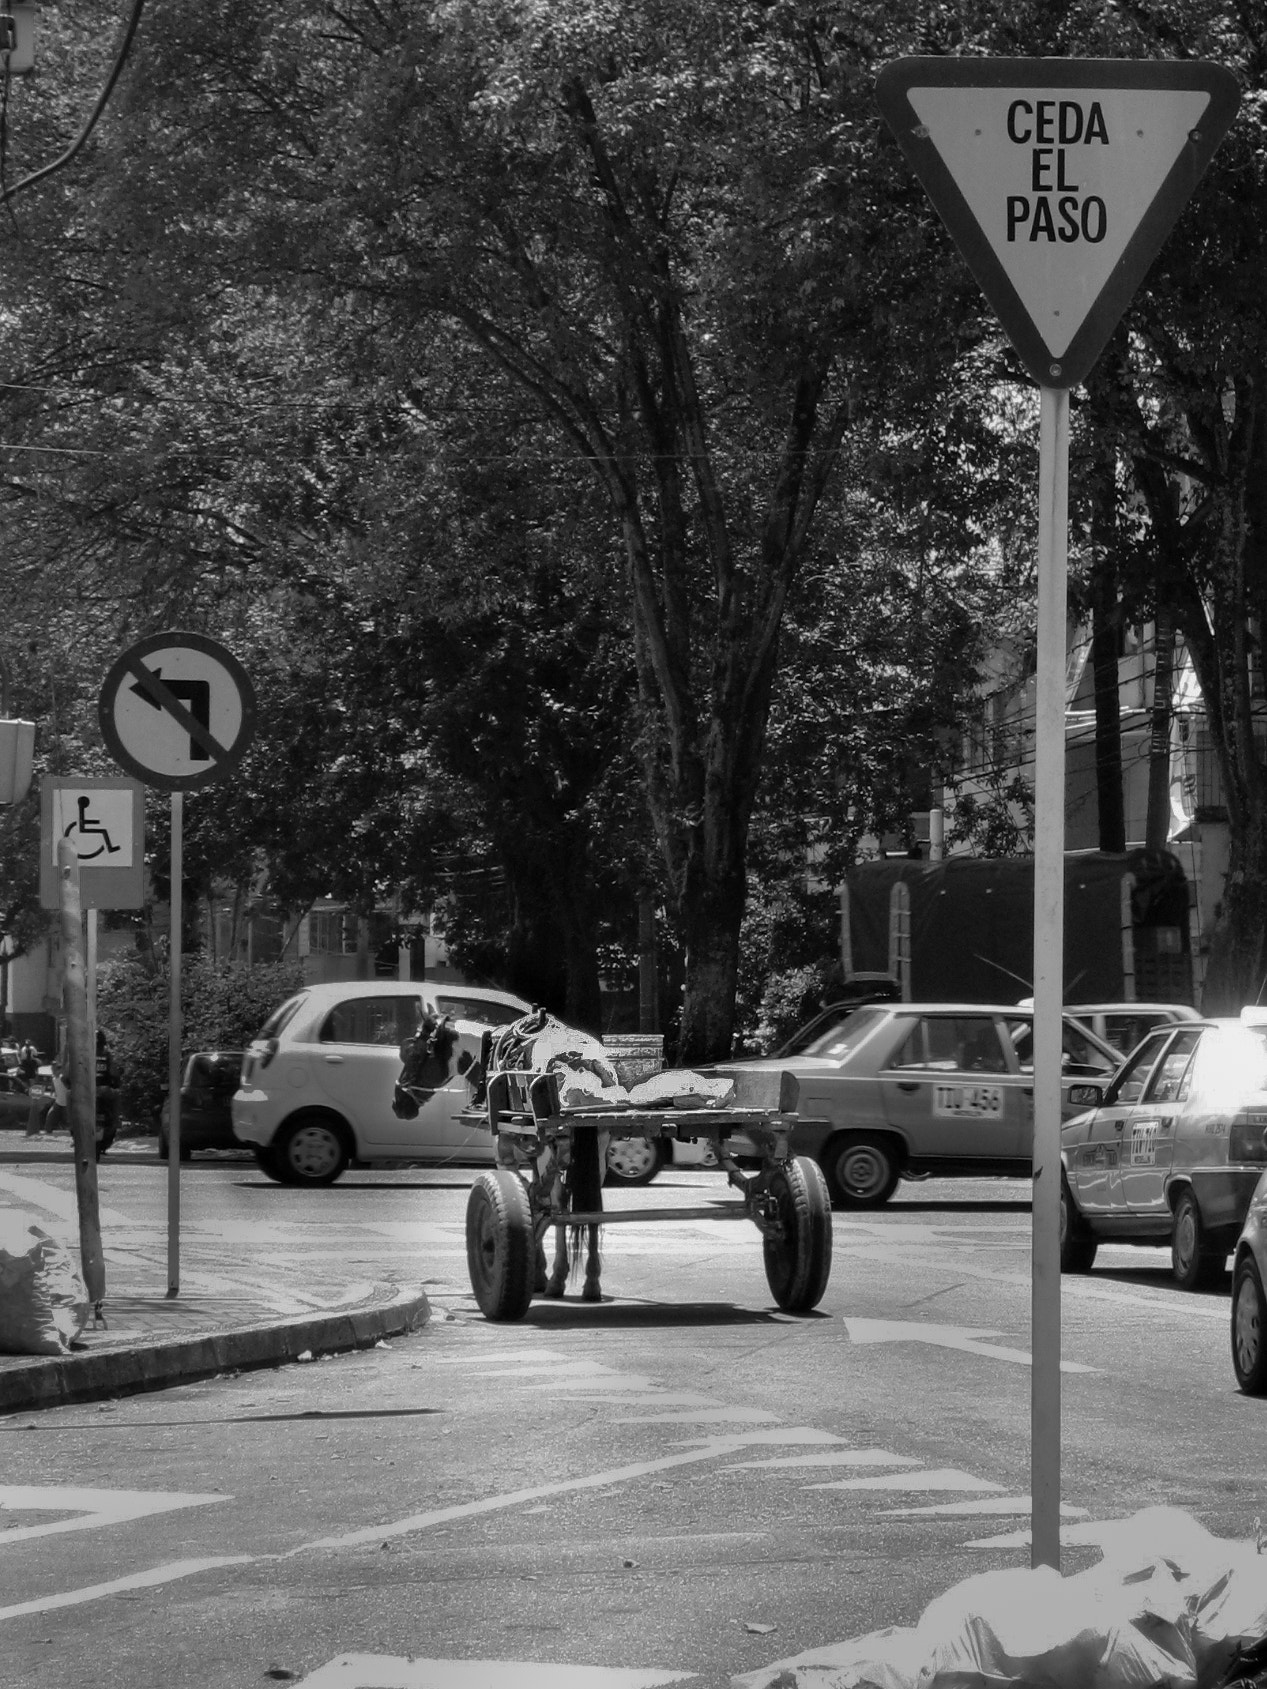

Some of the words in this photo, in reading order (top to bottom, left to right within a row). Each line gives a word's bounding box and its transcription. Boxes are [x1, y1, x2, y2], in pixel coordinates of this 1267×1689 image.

[1007, 100, 1110, 145] CEDA
[1032, 148, 1079, 192] EL
[1006, 196, 1107, 243] PASO
